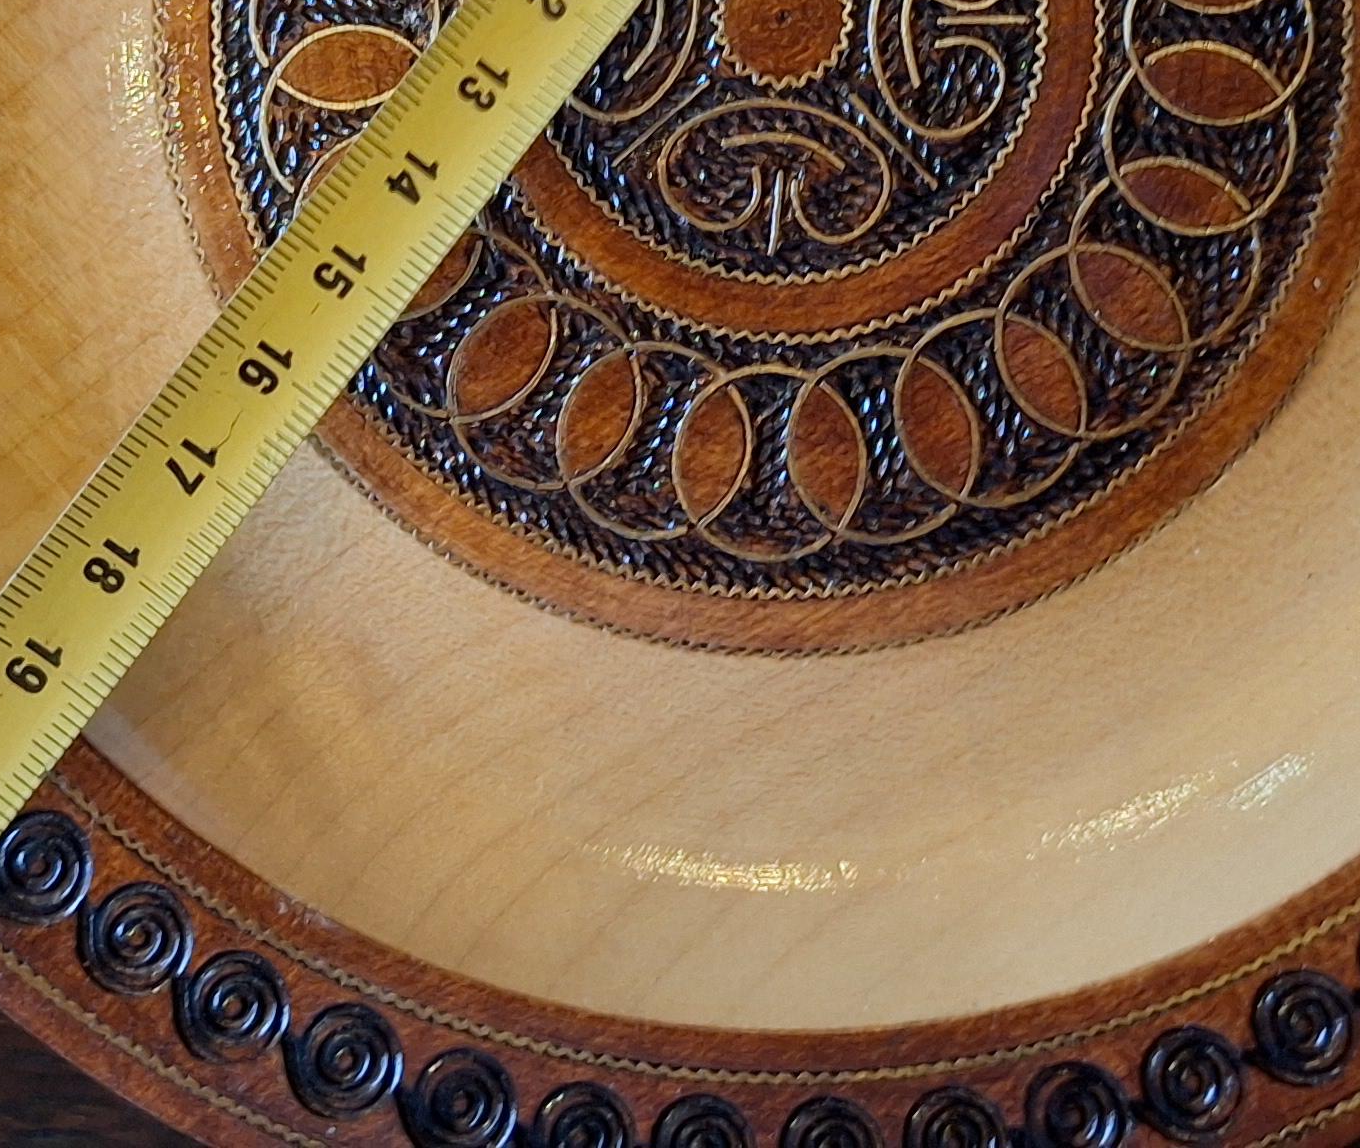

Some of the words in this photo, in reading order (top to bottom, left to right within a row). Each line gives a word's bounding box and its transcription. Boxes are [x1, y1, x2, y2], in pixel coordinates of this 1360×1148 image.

[458, 59, 509, 112] 13
[385, 151, 439, 206] 14
[313, 245, 367, 300] 15
[238, 340, 293, 395] 16
[165, 438, 218, 497] 17
[83, 538, 140, 594] 18
[5, 637, 63, 694] 19
